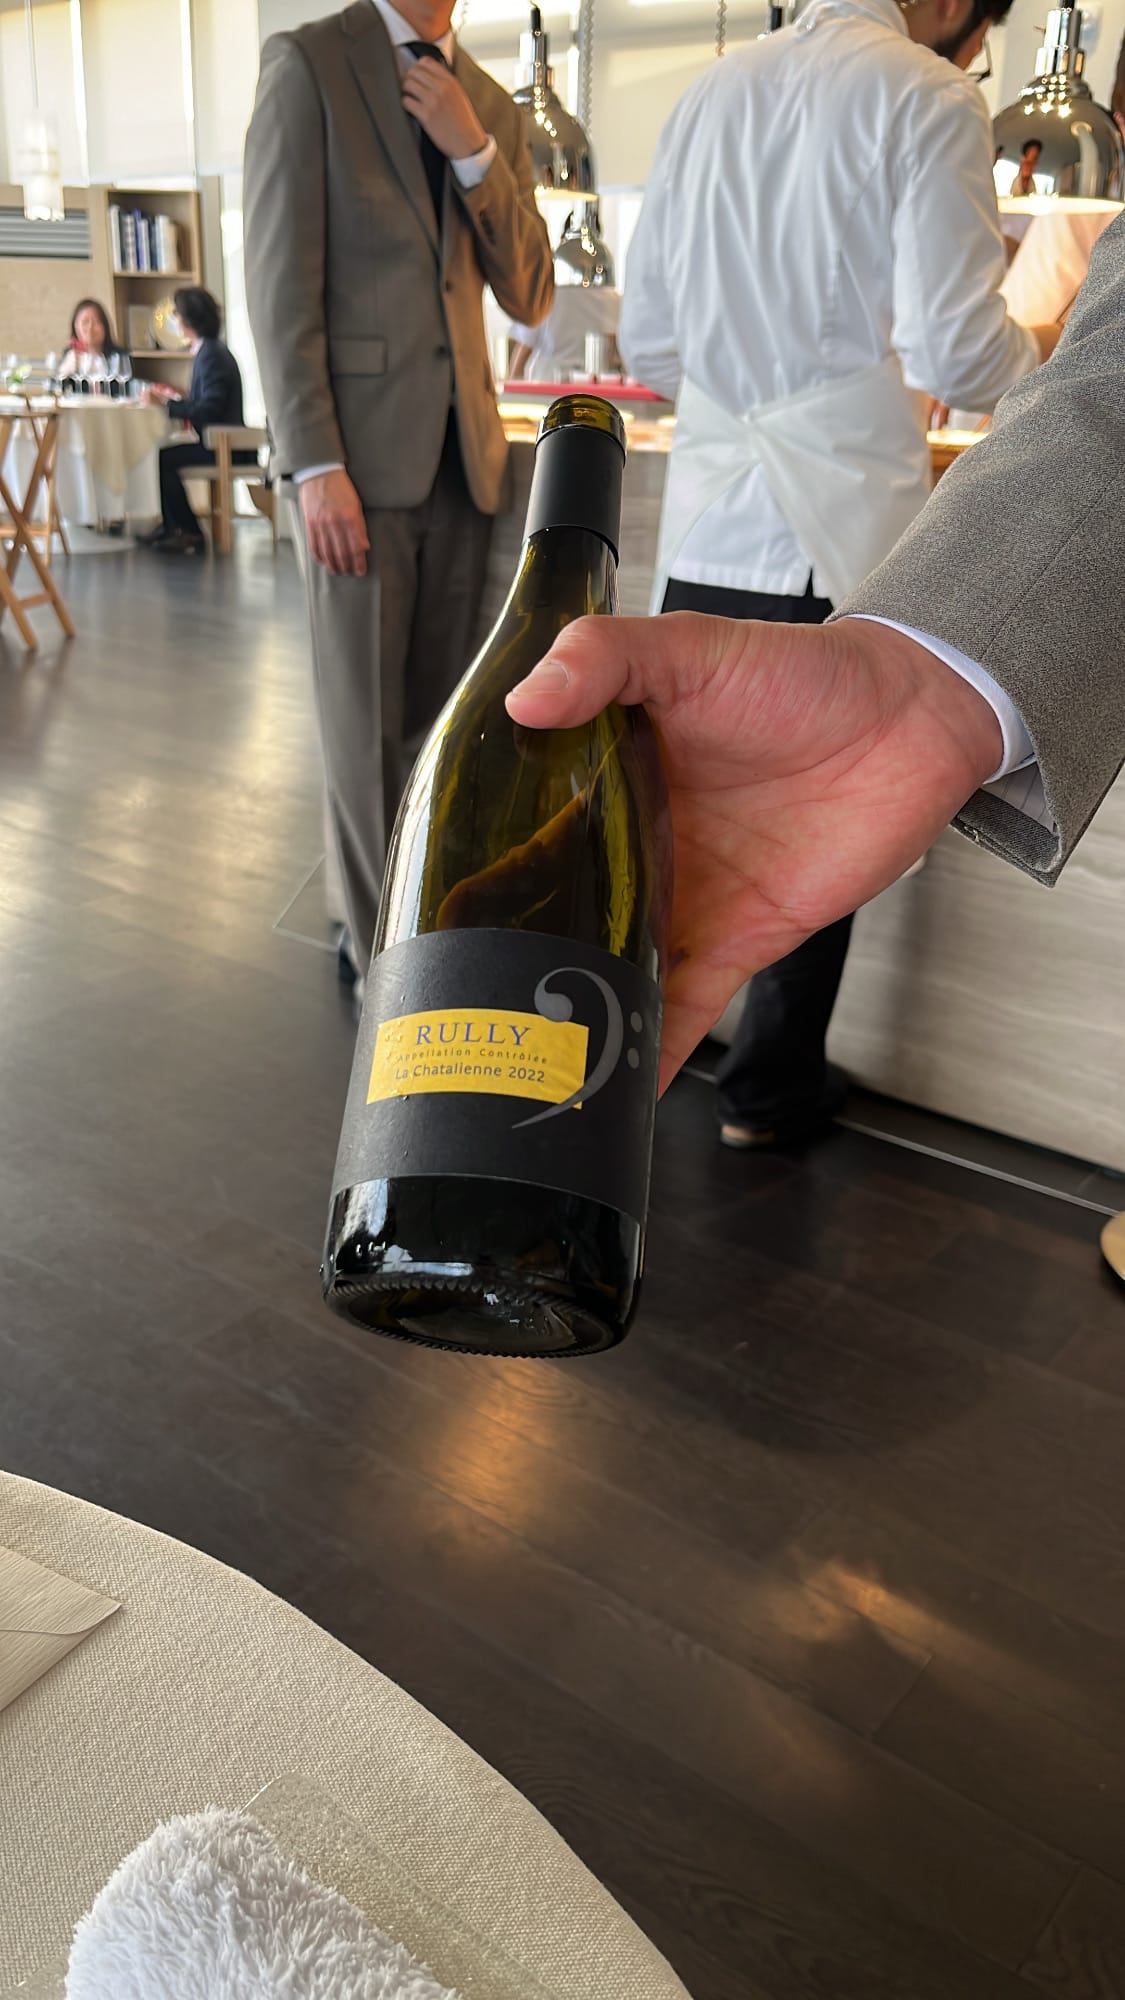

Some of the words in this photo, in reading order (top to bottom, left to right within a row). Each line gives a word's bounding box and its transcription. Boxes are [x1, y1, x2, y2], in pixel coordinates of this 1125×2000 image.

[416, 1022, 531, 1046] RULLY
[396, 1048, 471, 1063] Appellation
[395, 1068, 409, 1080] La
[508, 1066, 546, 1083] 2022
